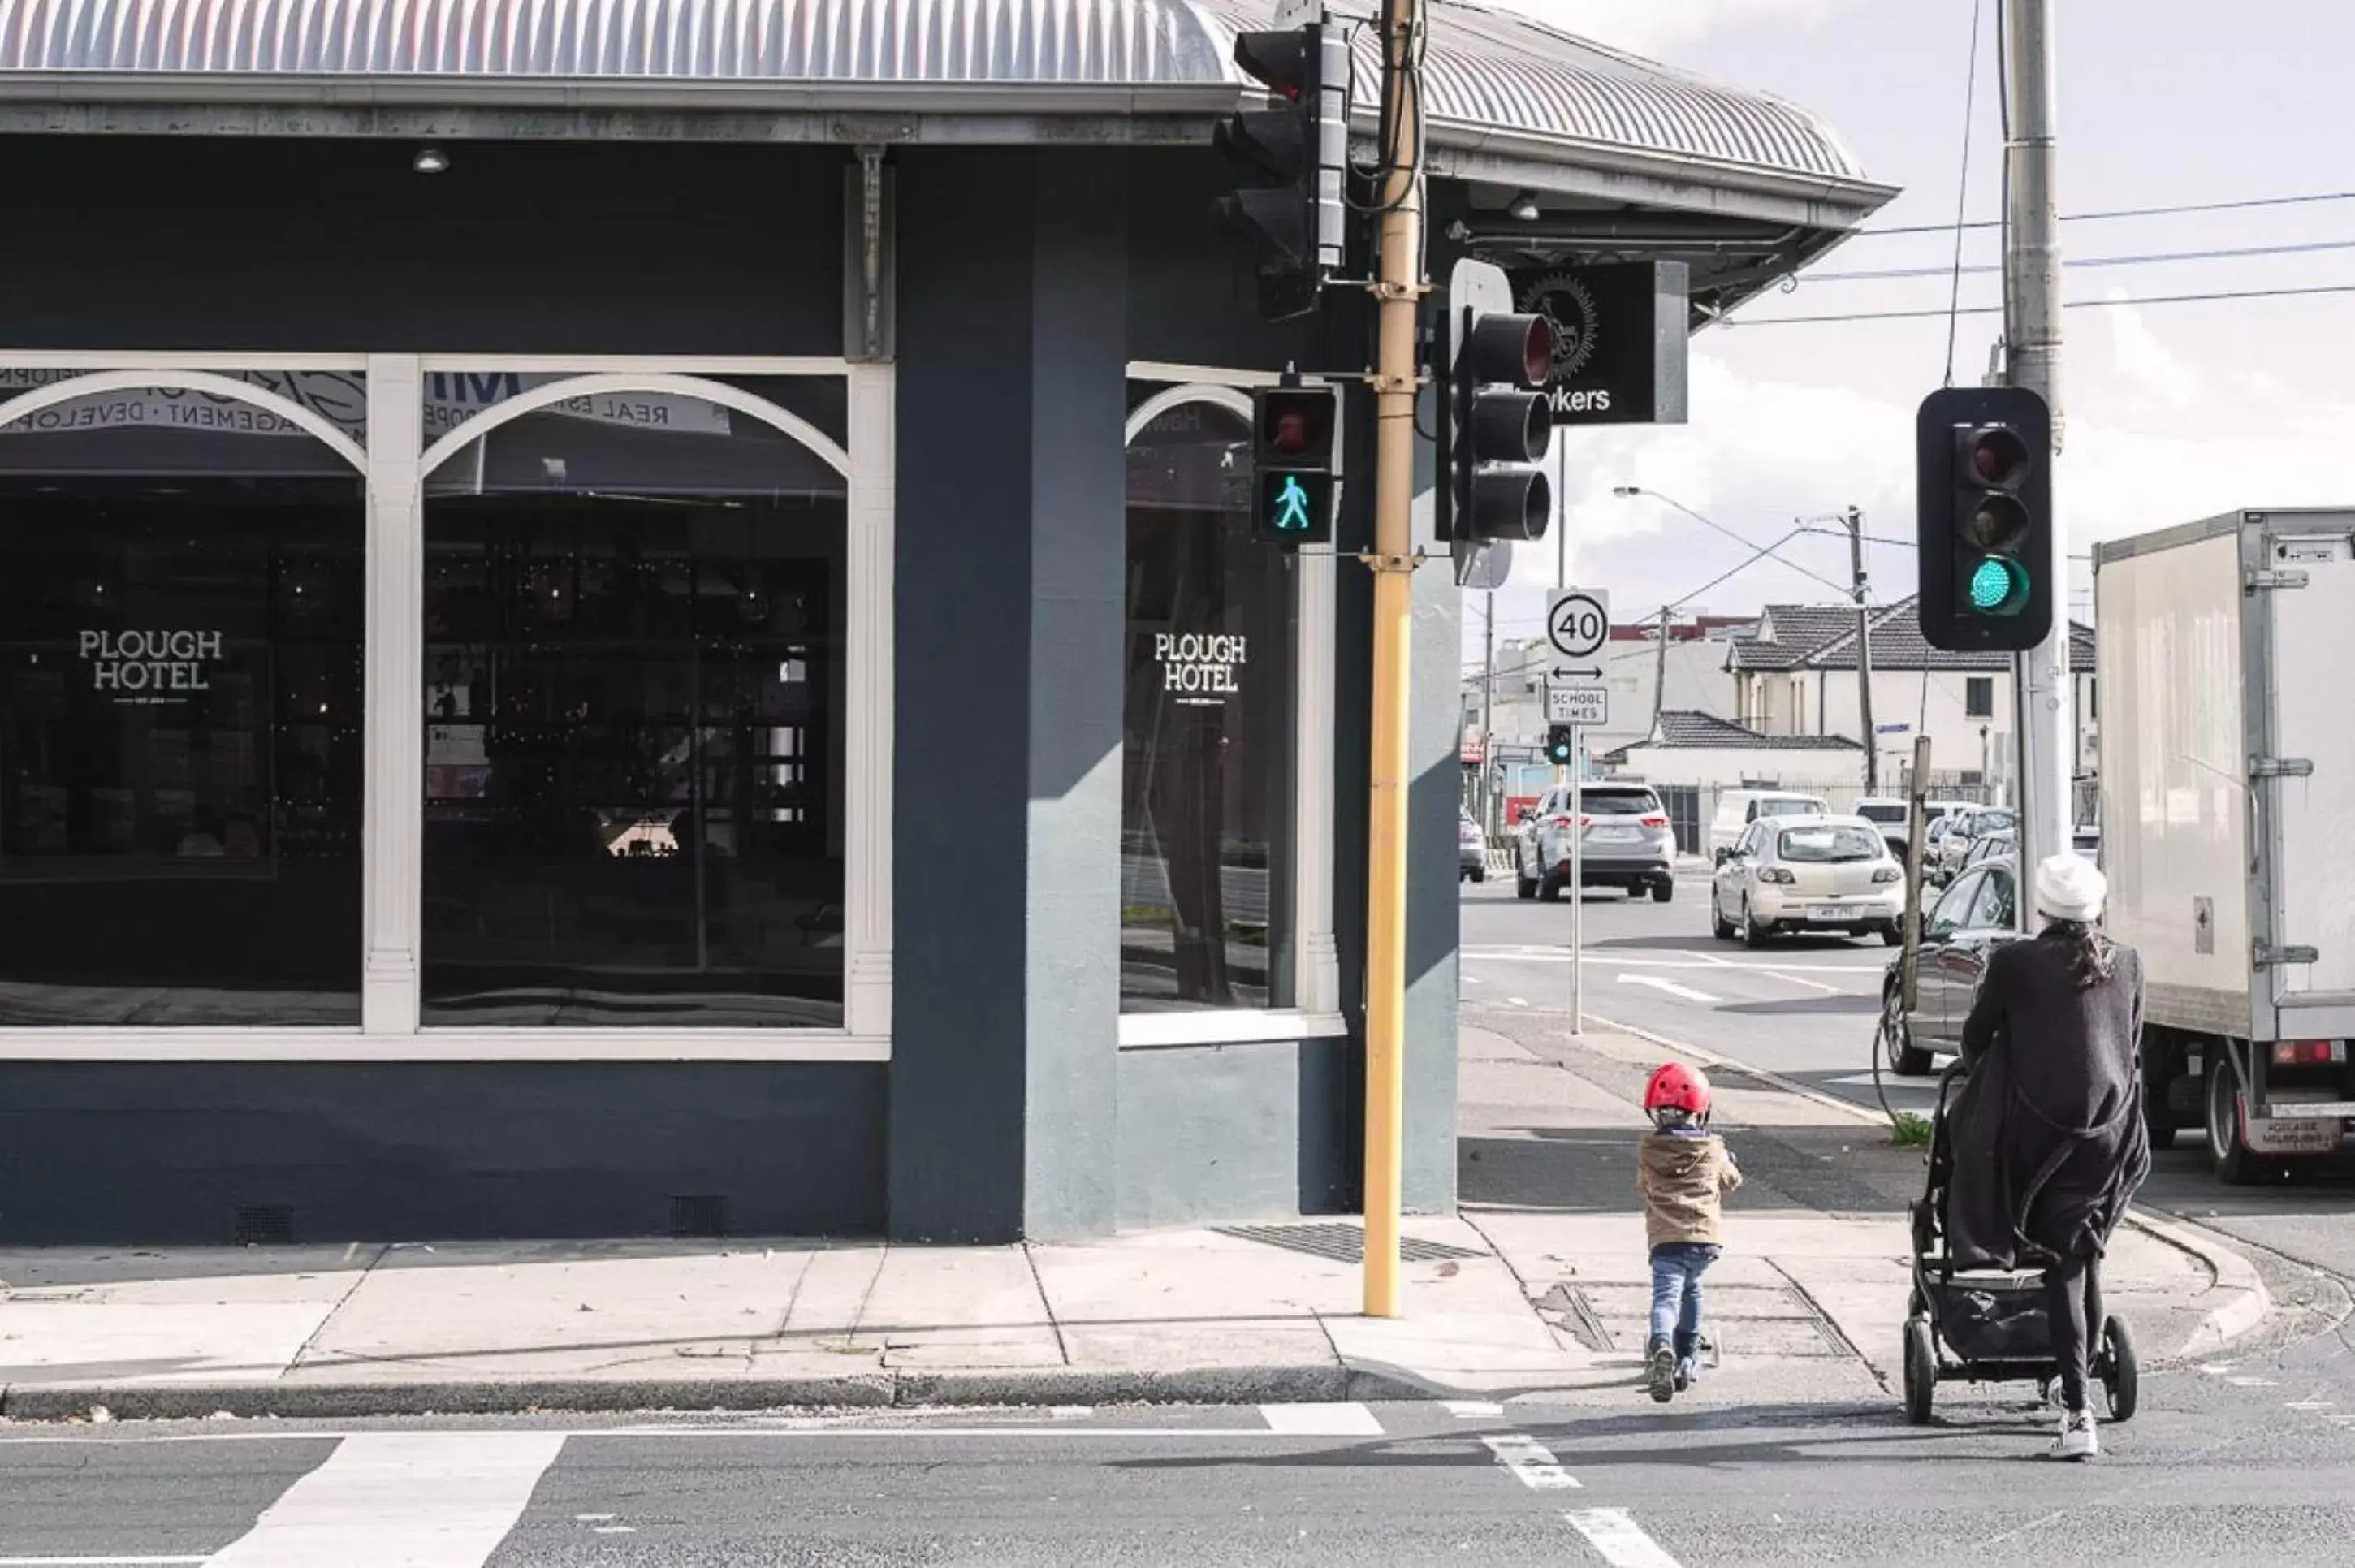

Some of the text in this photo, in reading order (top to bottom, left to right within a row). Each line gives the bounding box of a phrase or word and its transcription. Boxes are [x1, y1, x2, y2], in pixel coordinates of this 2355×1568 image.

[1557, 611, 1598, 640] 40
[79, 630, 223, 659] PLOUGH
[1155, 633, 1246, 663] PLOUGH
[93, 661, 209, 690] HOTEL
[1165, 663, 1238, 691] HOTEL
[1552, 693, 1603, 705] SCHOOL
[1558, 706, 1597, 719] TIMES
